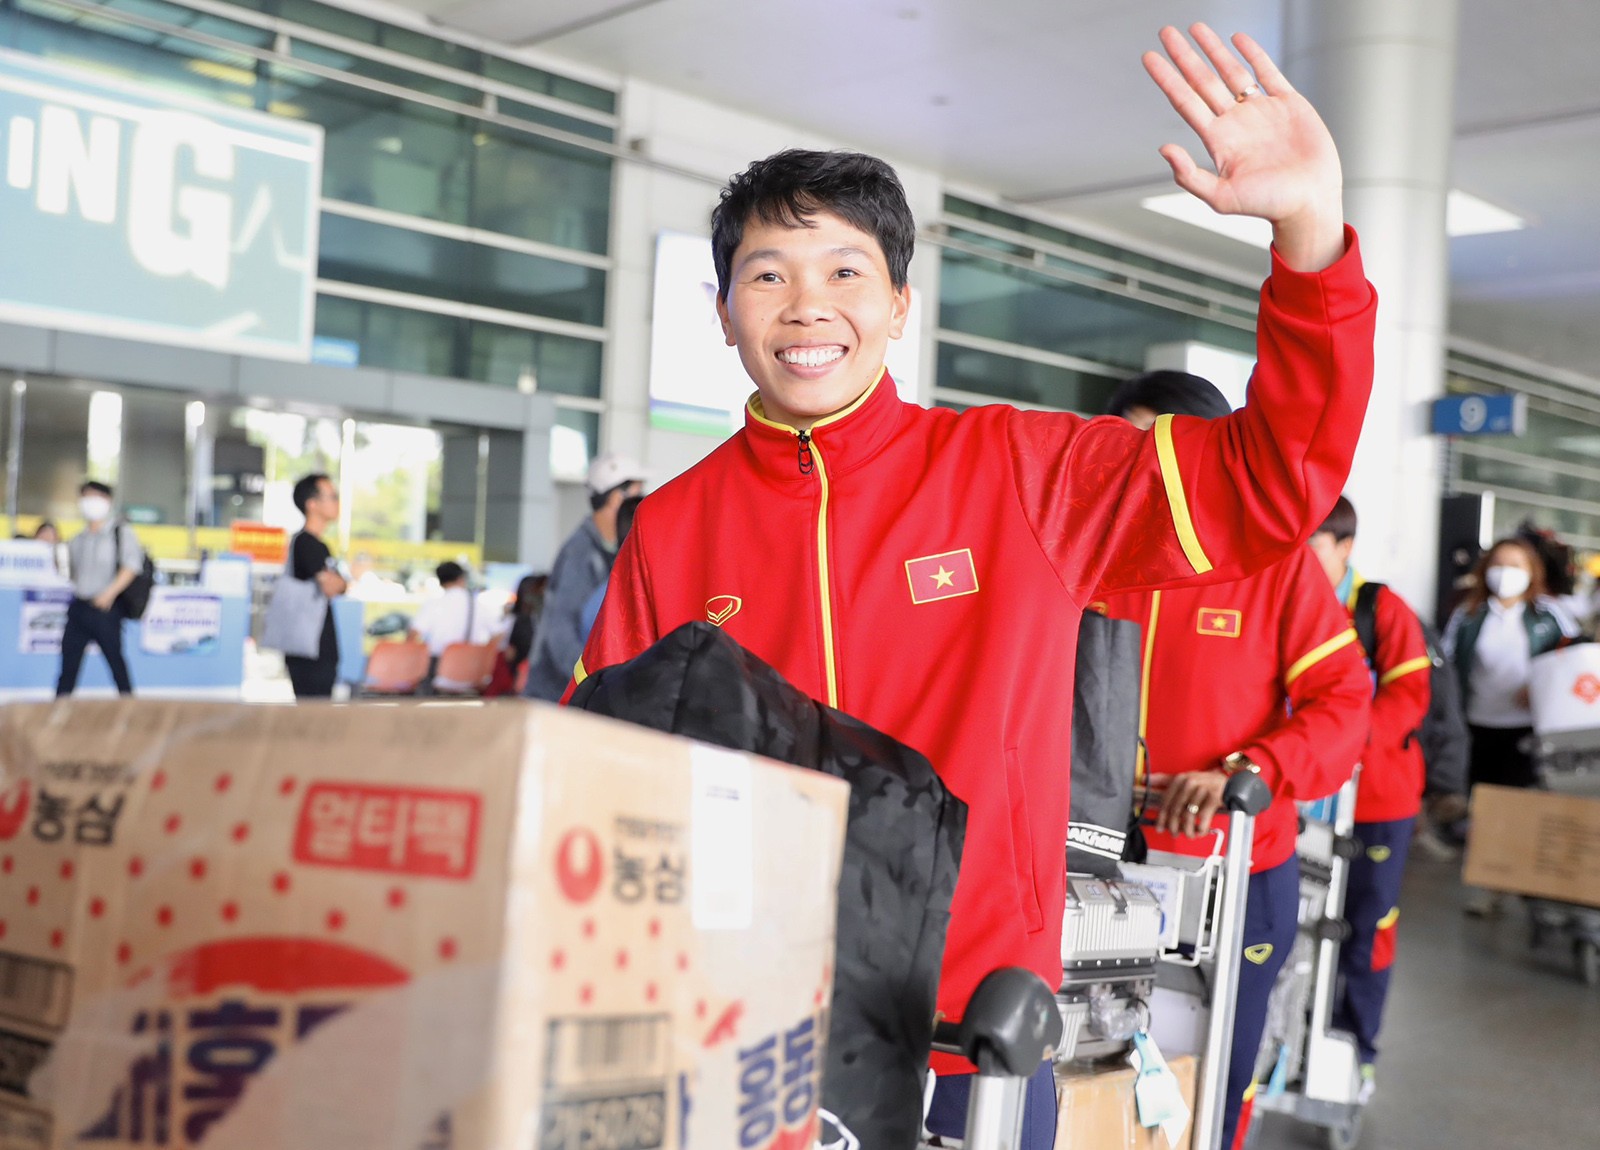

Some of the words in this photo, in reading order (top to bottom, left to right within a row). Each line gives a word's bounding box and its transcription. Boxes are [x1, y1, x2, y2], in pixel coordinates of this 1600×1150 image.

[1459, 396, 1487, 433] 9
[32, 784, 126, 847] 농심
[613, 844, 688, 905] 농심
